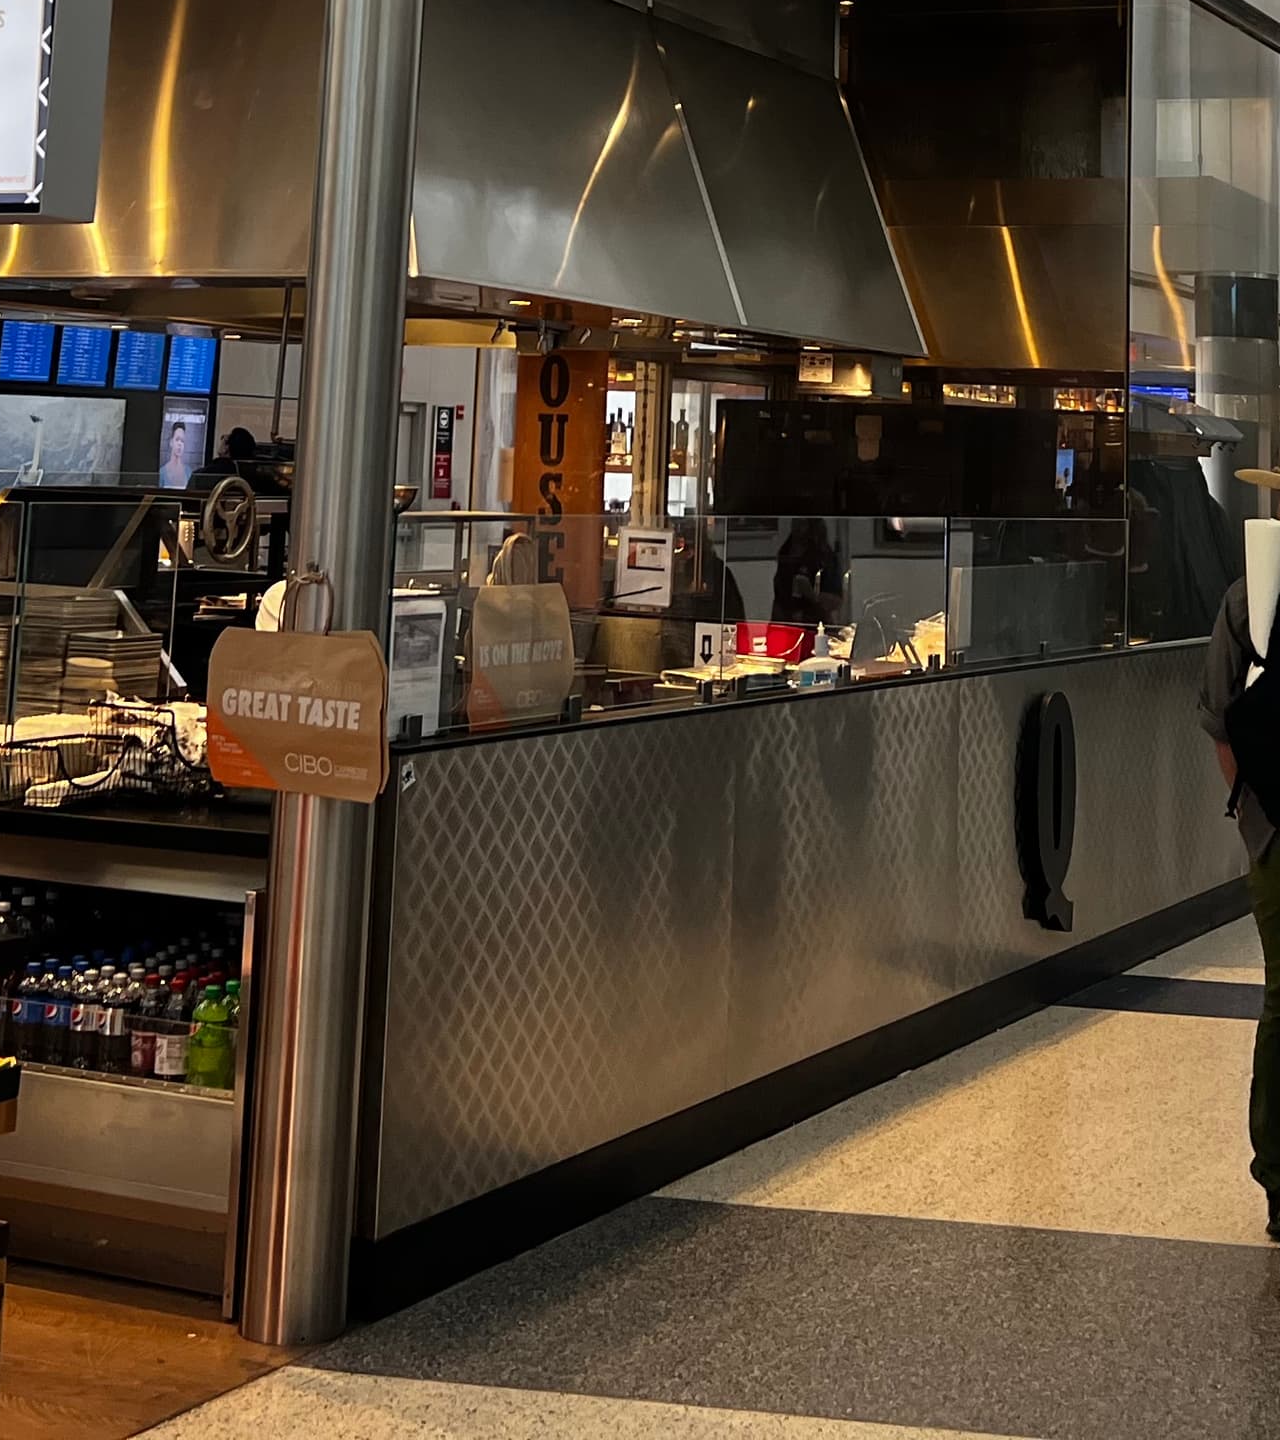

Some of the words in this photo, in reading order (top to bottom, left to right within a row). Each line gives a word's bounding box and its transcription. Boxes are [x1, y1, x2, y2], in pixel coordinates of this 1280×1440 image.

[492, 643, 509, 666] ON
[222, 687, 292, 722] GREAT
[298, 696, 361, 731] TASTE
[284, 752, 333, 776] CIBO
[1036, 690, 1076, 932] Q
